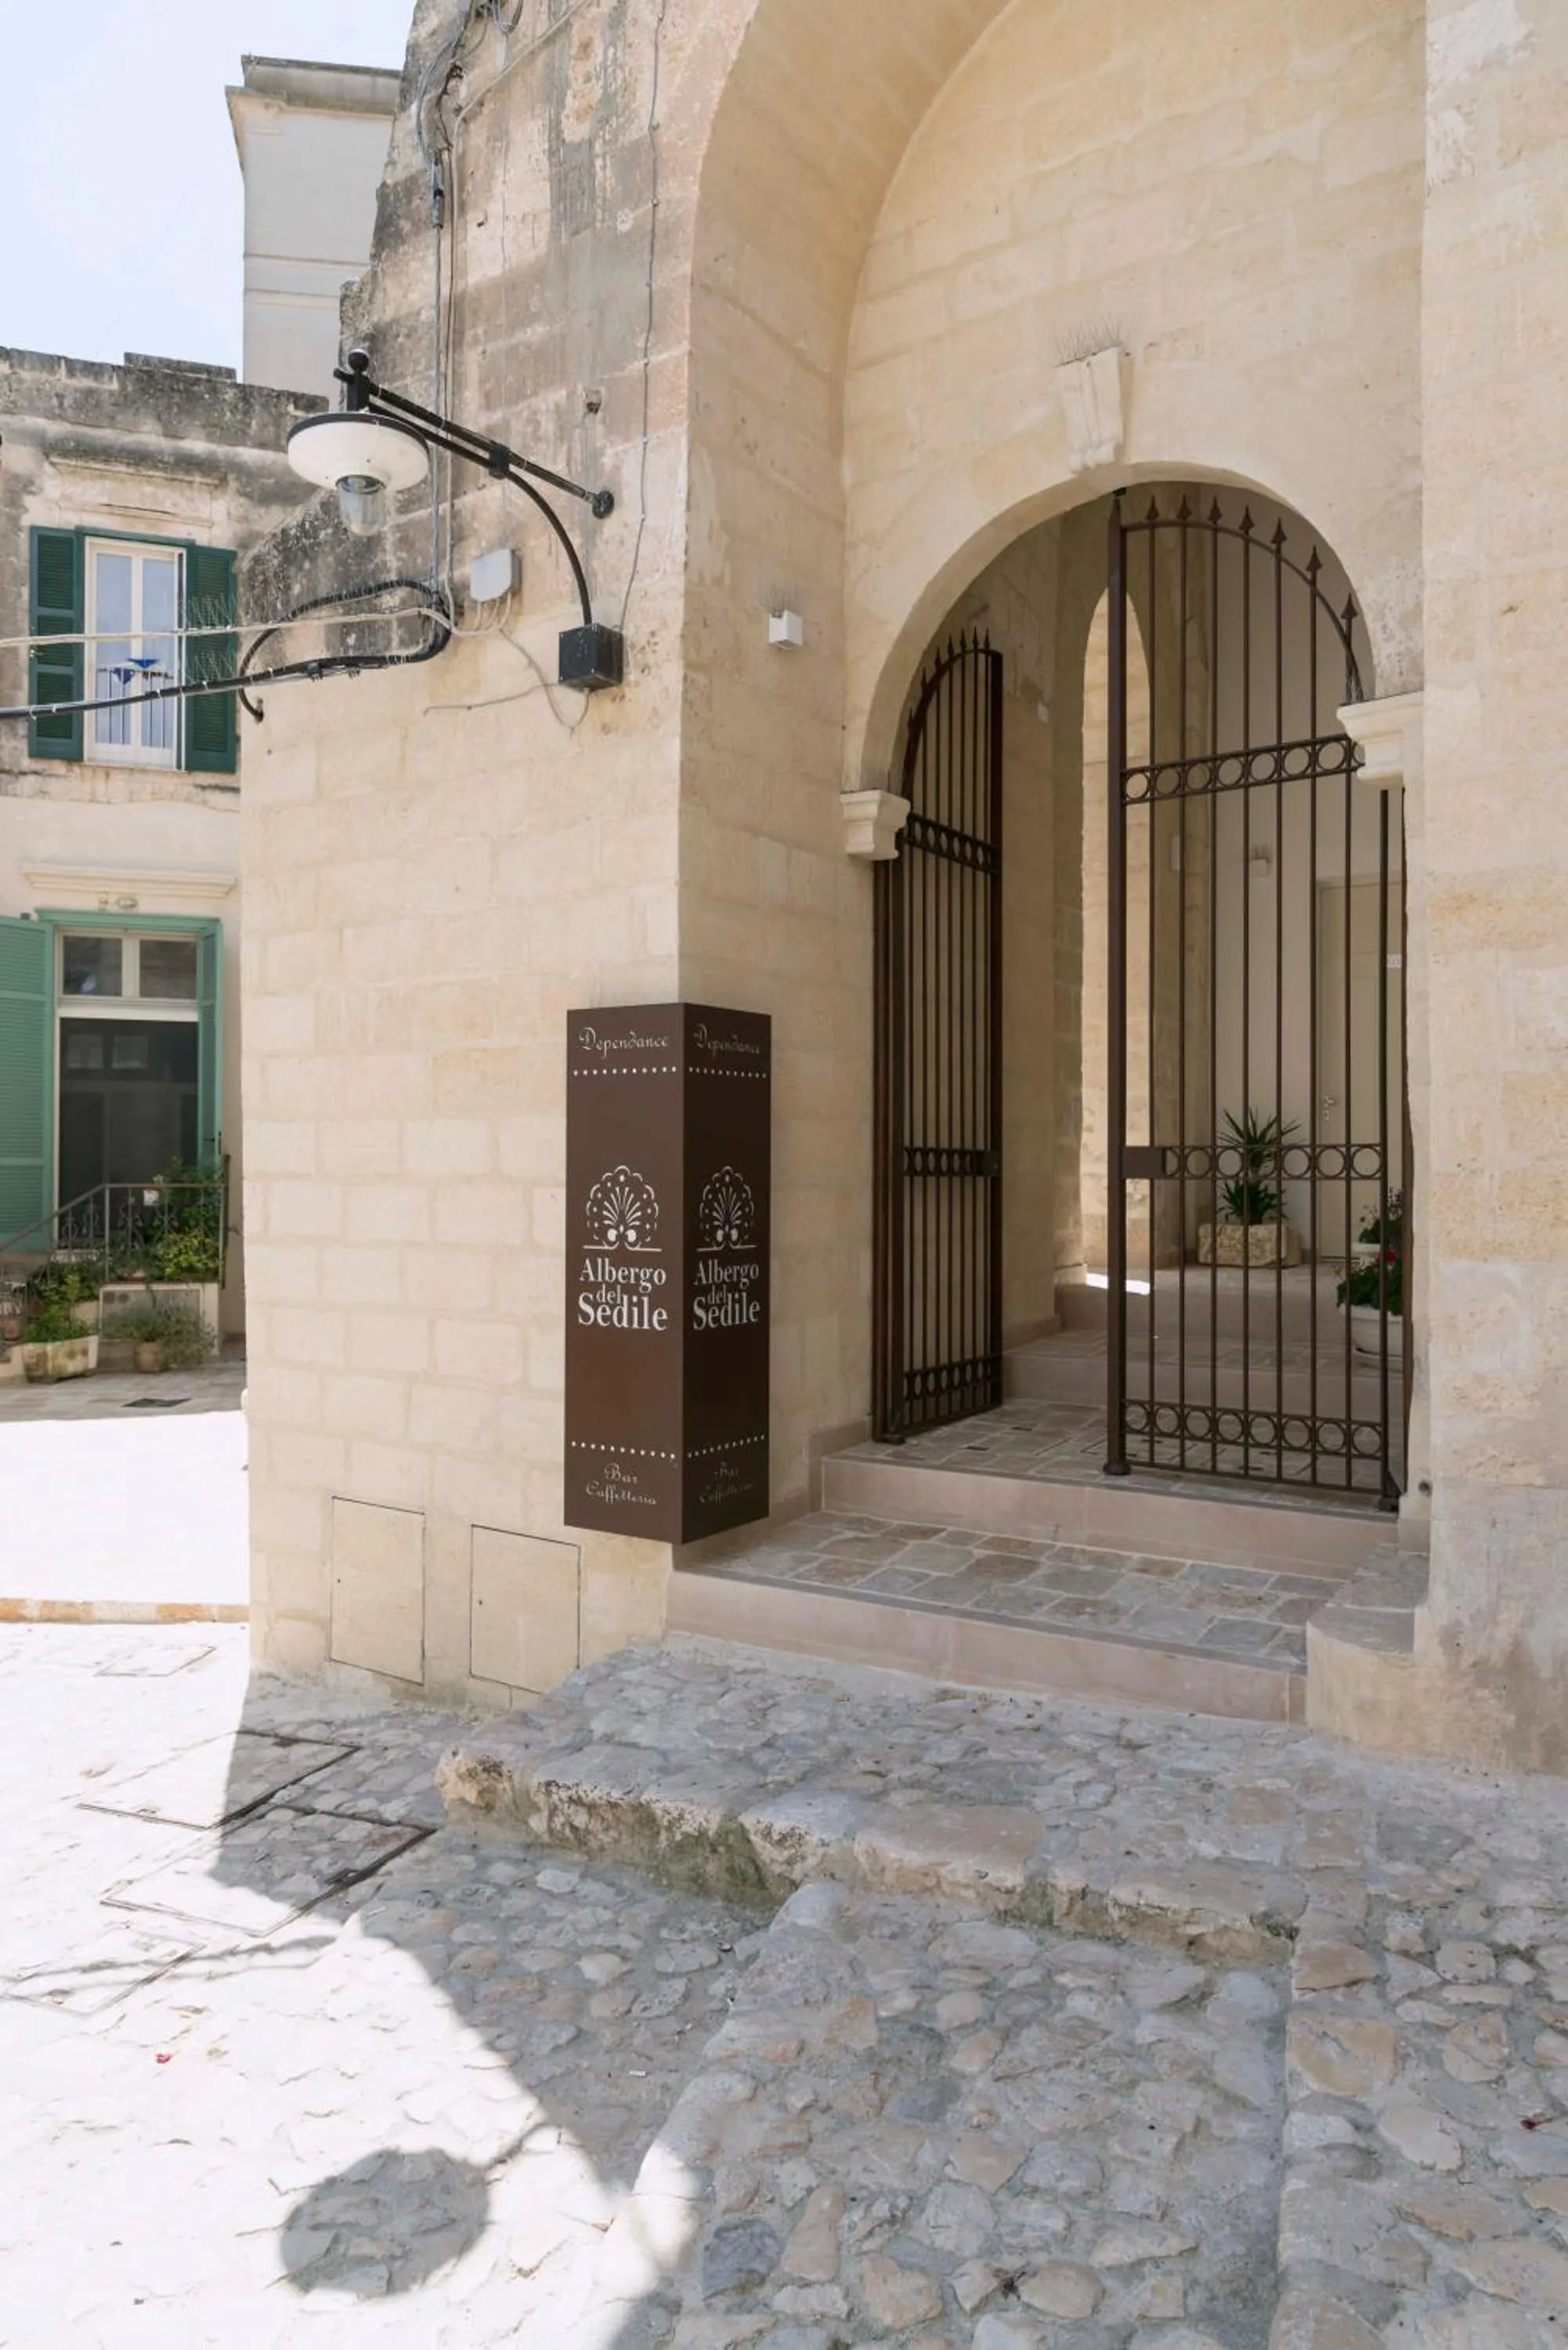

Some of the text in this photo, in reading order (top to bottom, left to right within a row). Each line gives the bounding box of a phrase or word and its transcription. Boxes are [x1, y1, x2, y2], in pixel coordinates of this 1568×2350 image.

[579, 1257, 667, 1293] Albergo
[694, 1260, 759, 1289] Albergo
[596, 1283, 621, 1303] del
[707, 1285, 726, 1304] del
[578, 1292, 668, 1331] Sedile
[693, 1292, 761, 1331] Sedile
[603, 1462, 639, 1484] Bar
